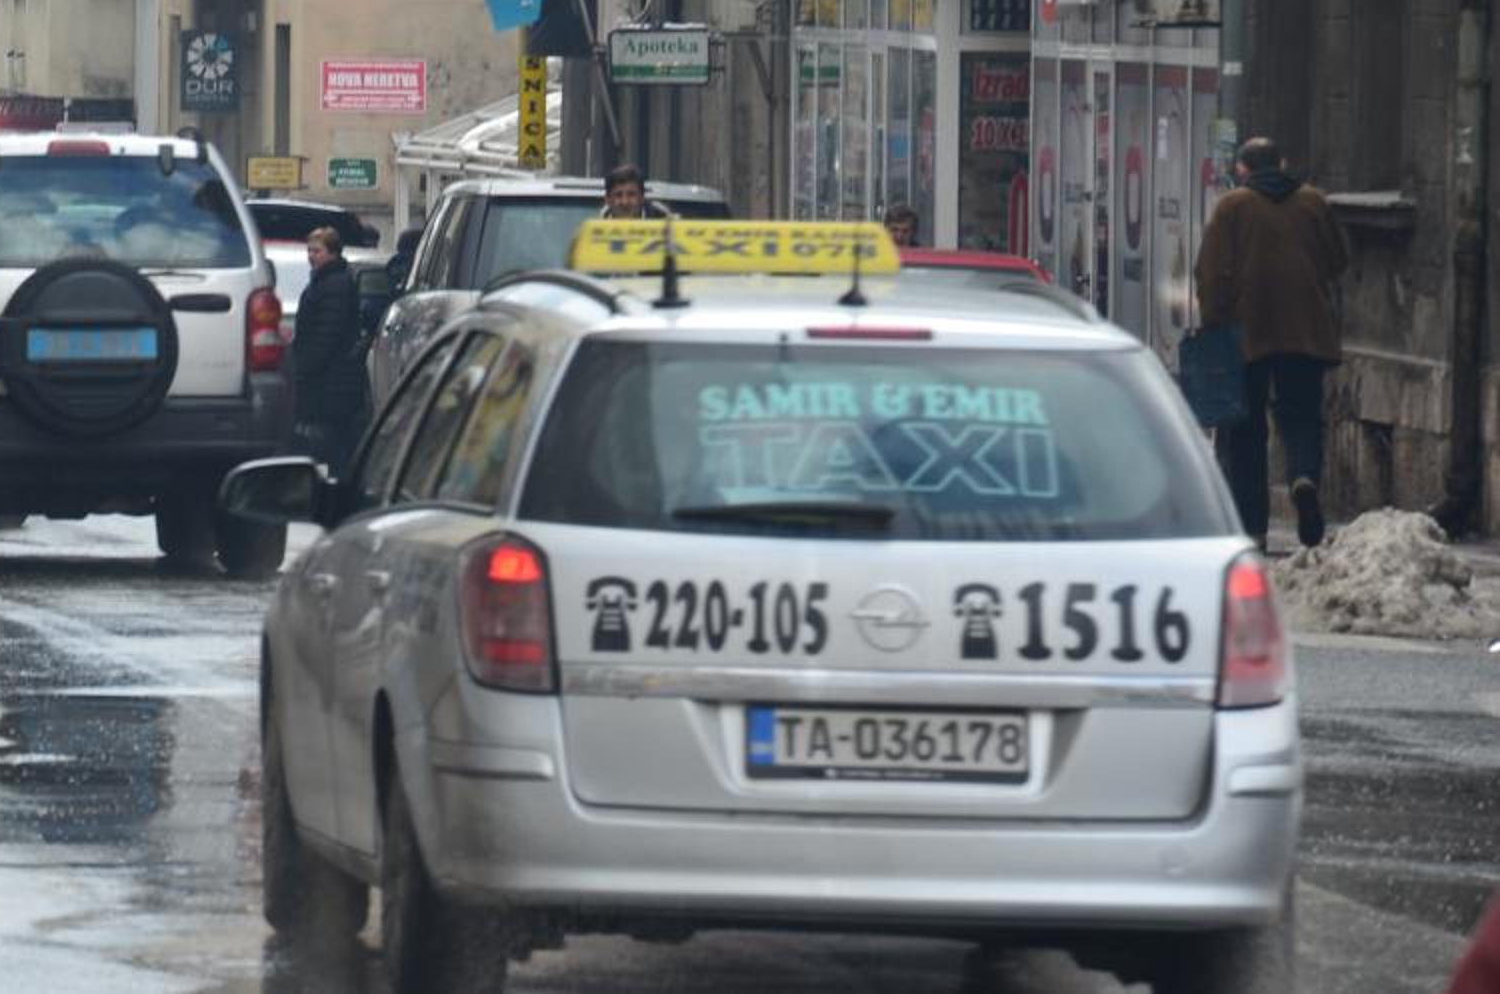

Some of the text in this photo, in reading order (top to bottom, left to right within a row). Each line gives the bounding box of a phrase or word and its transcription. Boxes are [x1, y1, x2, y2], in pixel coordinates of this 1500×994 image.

[625, 36, 699, 56] Apoteka
[593, 239, 779, 256] TAXI
[698, 381, 859, 420] SAMIR
[917, 384, 1050, 425] EMIR
[700, 419, 1059, 498] TAXI
[644, 579, 829, 655] 220-105
[1017, 581, 1191, 663] 1516
[776, 716, 1025, 765] TA-036178
